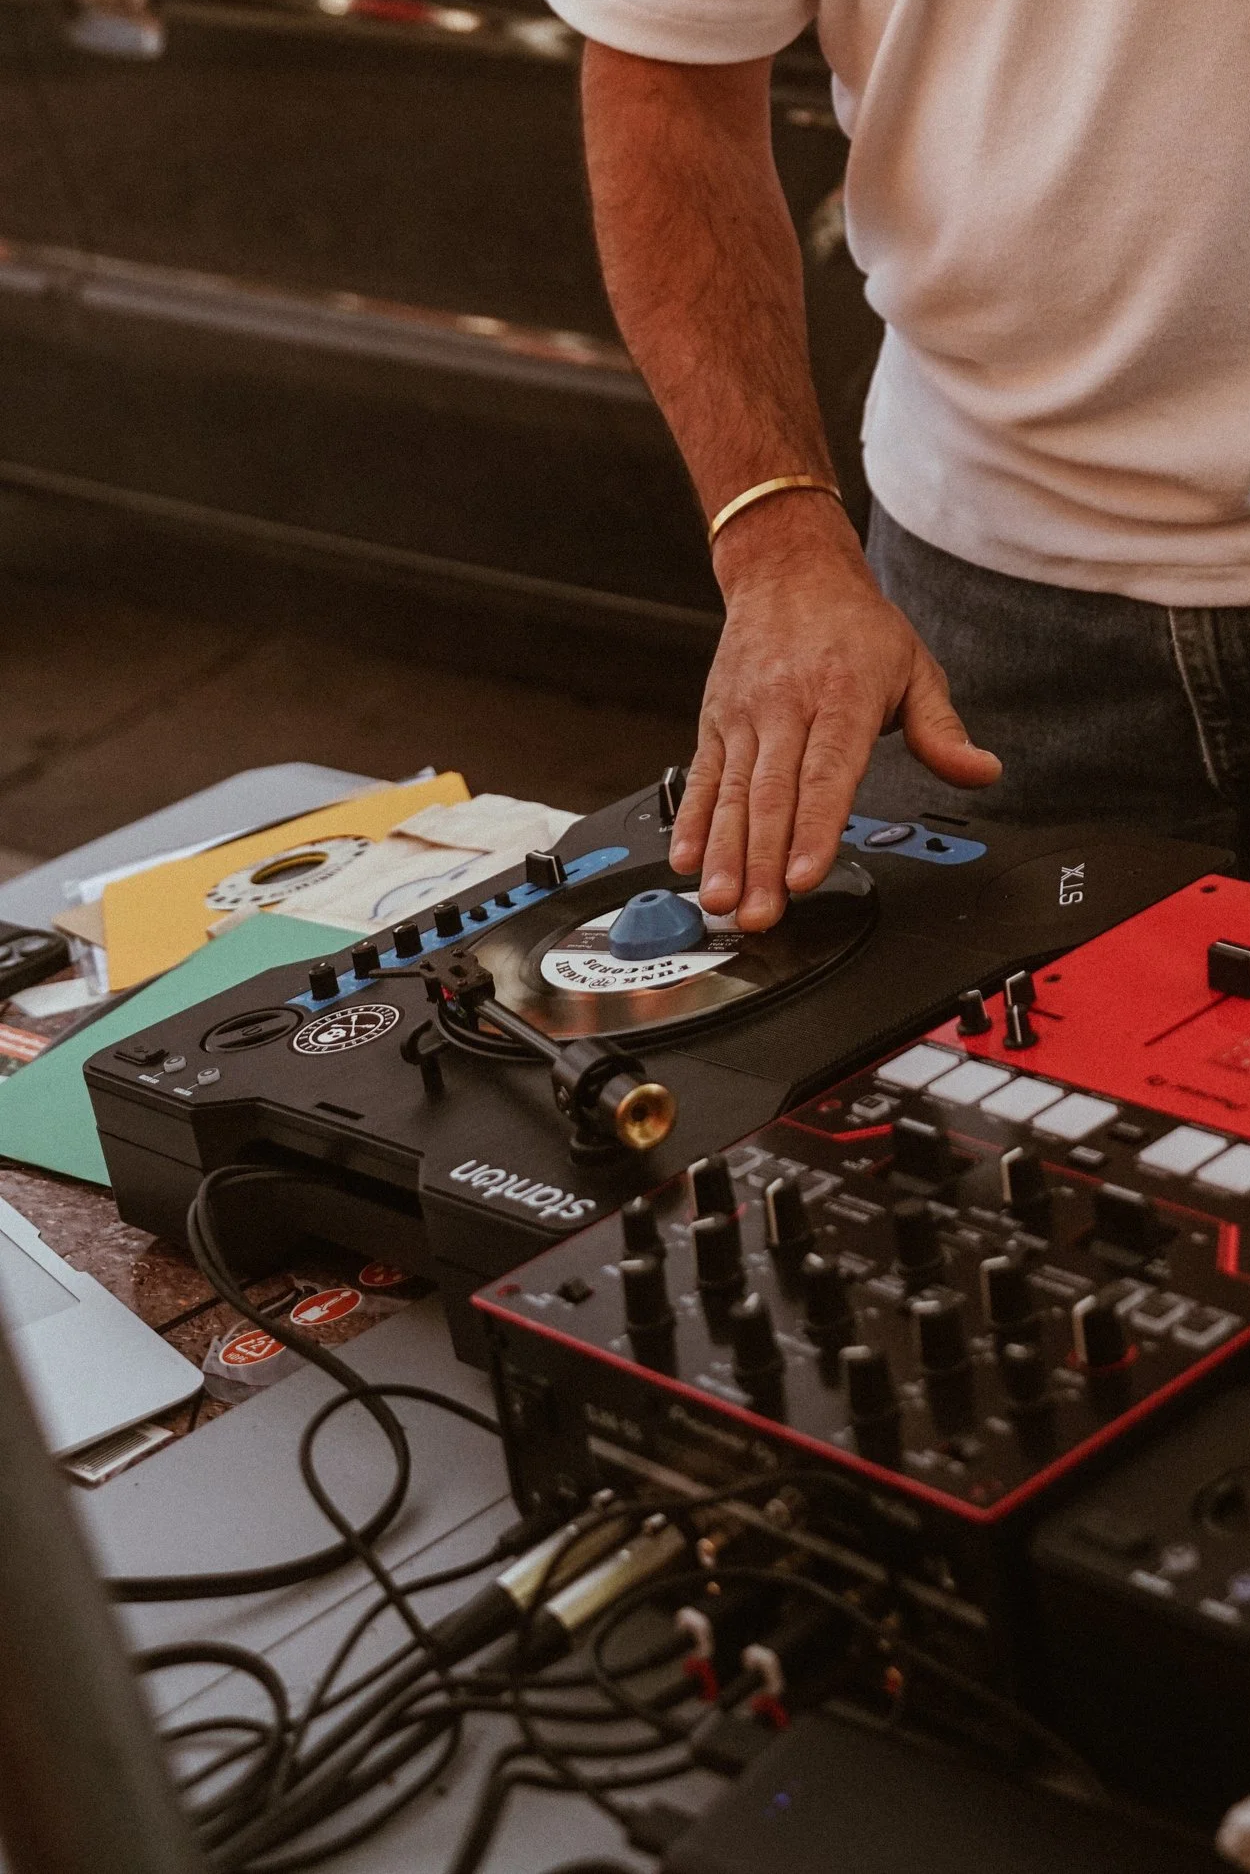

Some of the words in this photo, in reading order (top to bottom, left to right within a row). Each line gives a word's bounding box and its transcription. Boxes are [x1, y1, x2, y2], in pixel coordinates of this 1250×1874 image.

[1059, 862, 1085, 905] STX
[555, 959, 594, 985] NIGHT
[583, 959, 674, 976] RECORDS
[621, 963, 691, 986] FUNK
[450, 1159, 596, 1221] stanton
